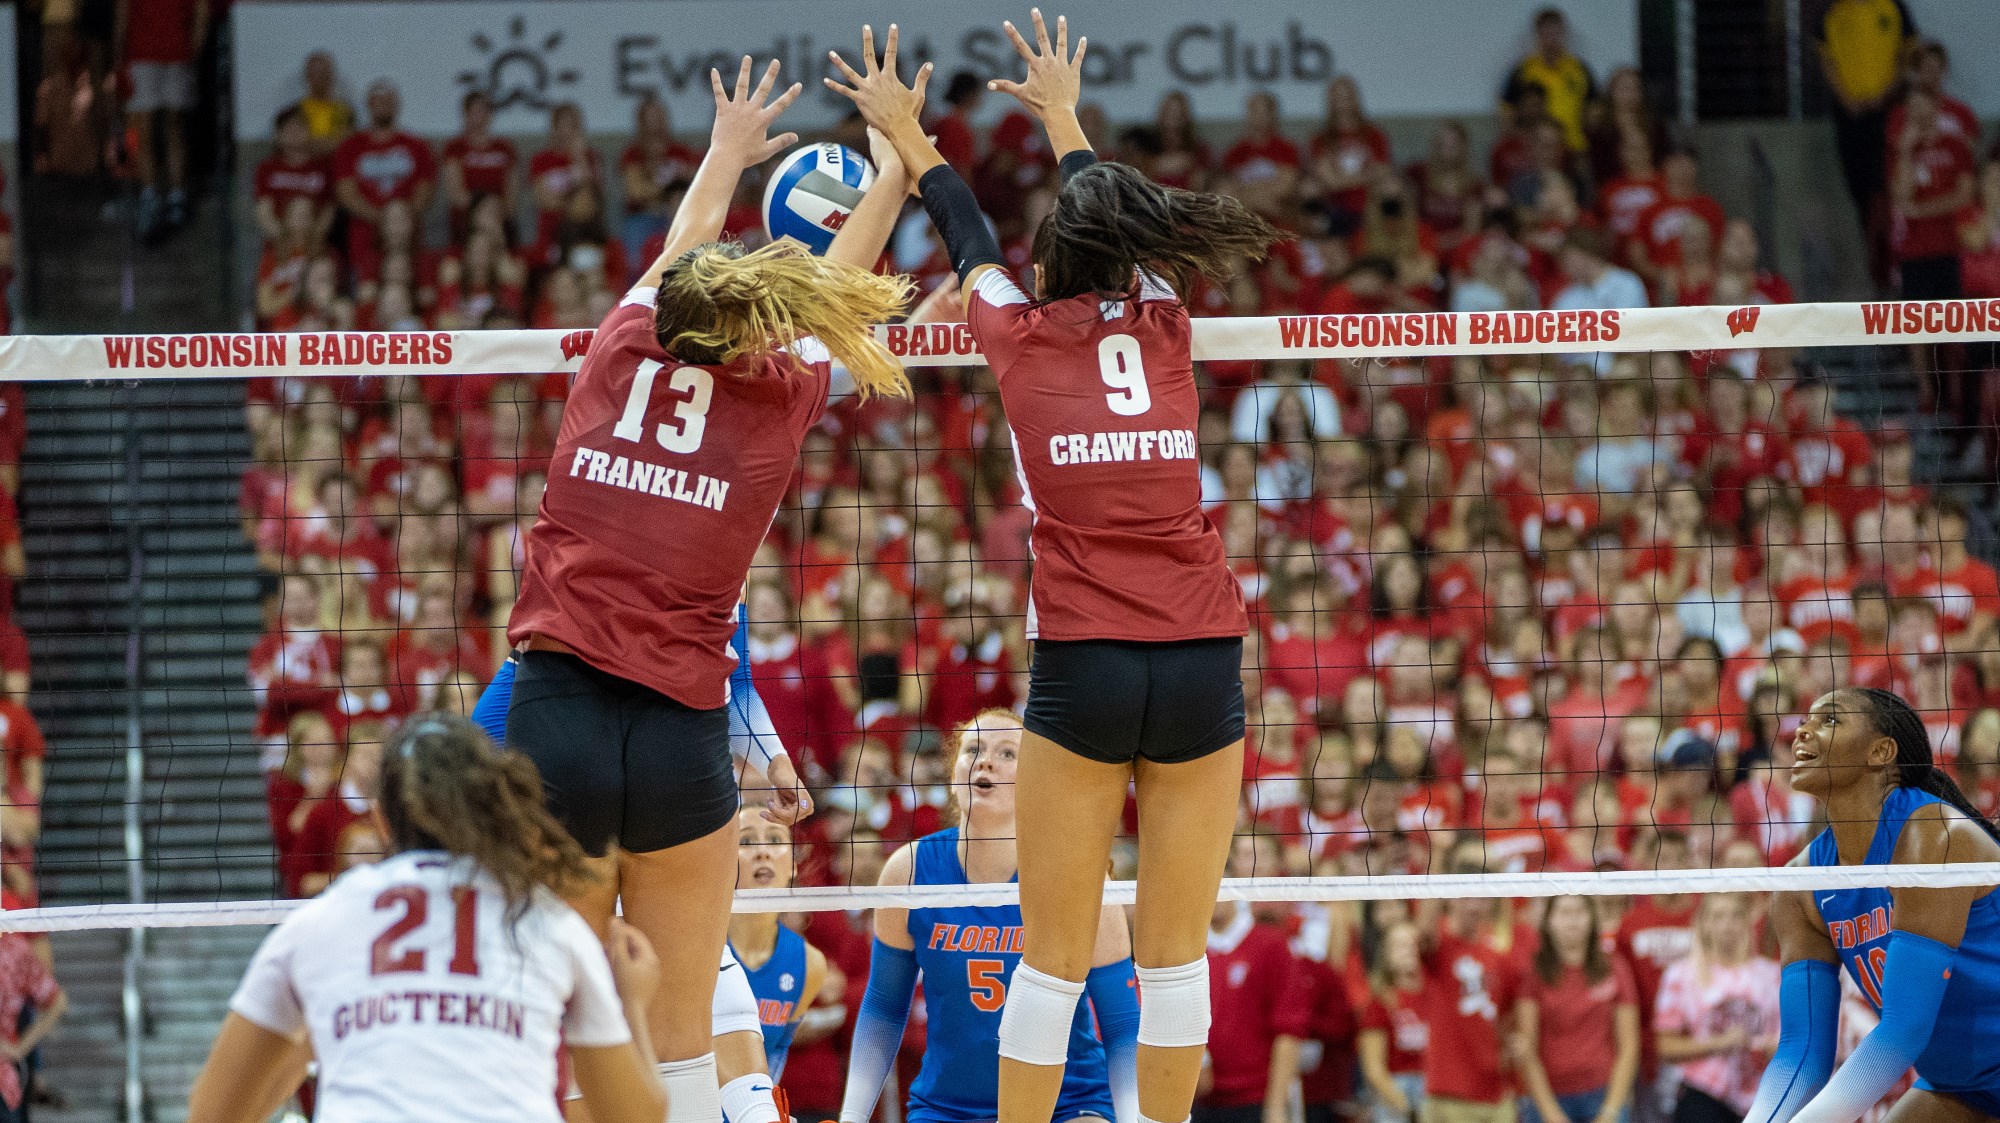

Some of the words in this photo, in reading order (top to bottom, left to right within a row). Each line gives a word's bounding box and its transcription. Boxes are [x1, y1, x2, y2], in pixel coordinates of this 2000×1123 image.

[961, 25, 1149, 86] Sar
[1166, 21, 1334, 85] Club
[1278, 313, 1458, 348] WISCONSIN
[1469, 310, 1621, 345] BADGERS
[1727, 306, 1761, 338] W
[103, 335, 287, 369] WISCONSIN
[299, 332, 453, 367] BADGERS
[1098, 333, 1152, 416] 9
[612, 357, 714, 454] 13
[1049, 429, 1196, 466] CRAWFORD
[569, 446, 730, 512] FRANKLIN
[370, 883, 479, 977] 21
[927, 922, 1025, 953] FLORID
[967, 959, 1005, 1012] 5
[333, 990, 525, 1040] GUCTEKIN
